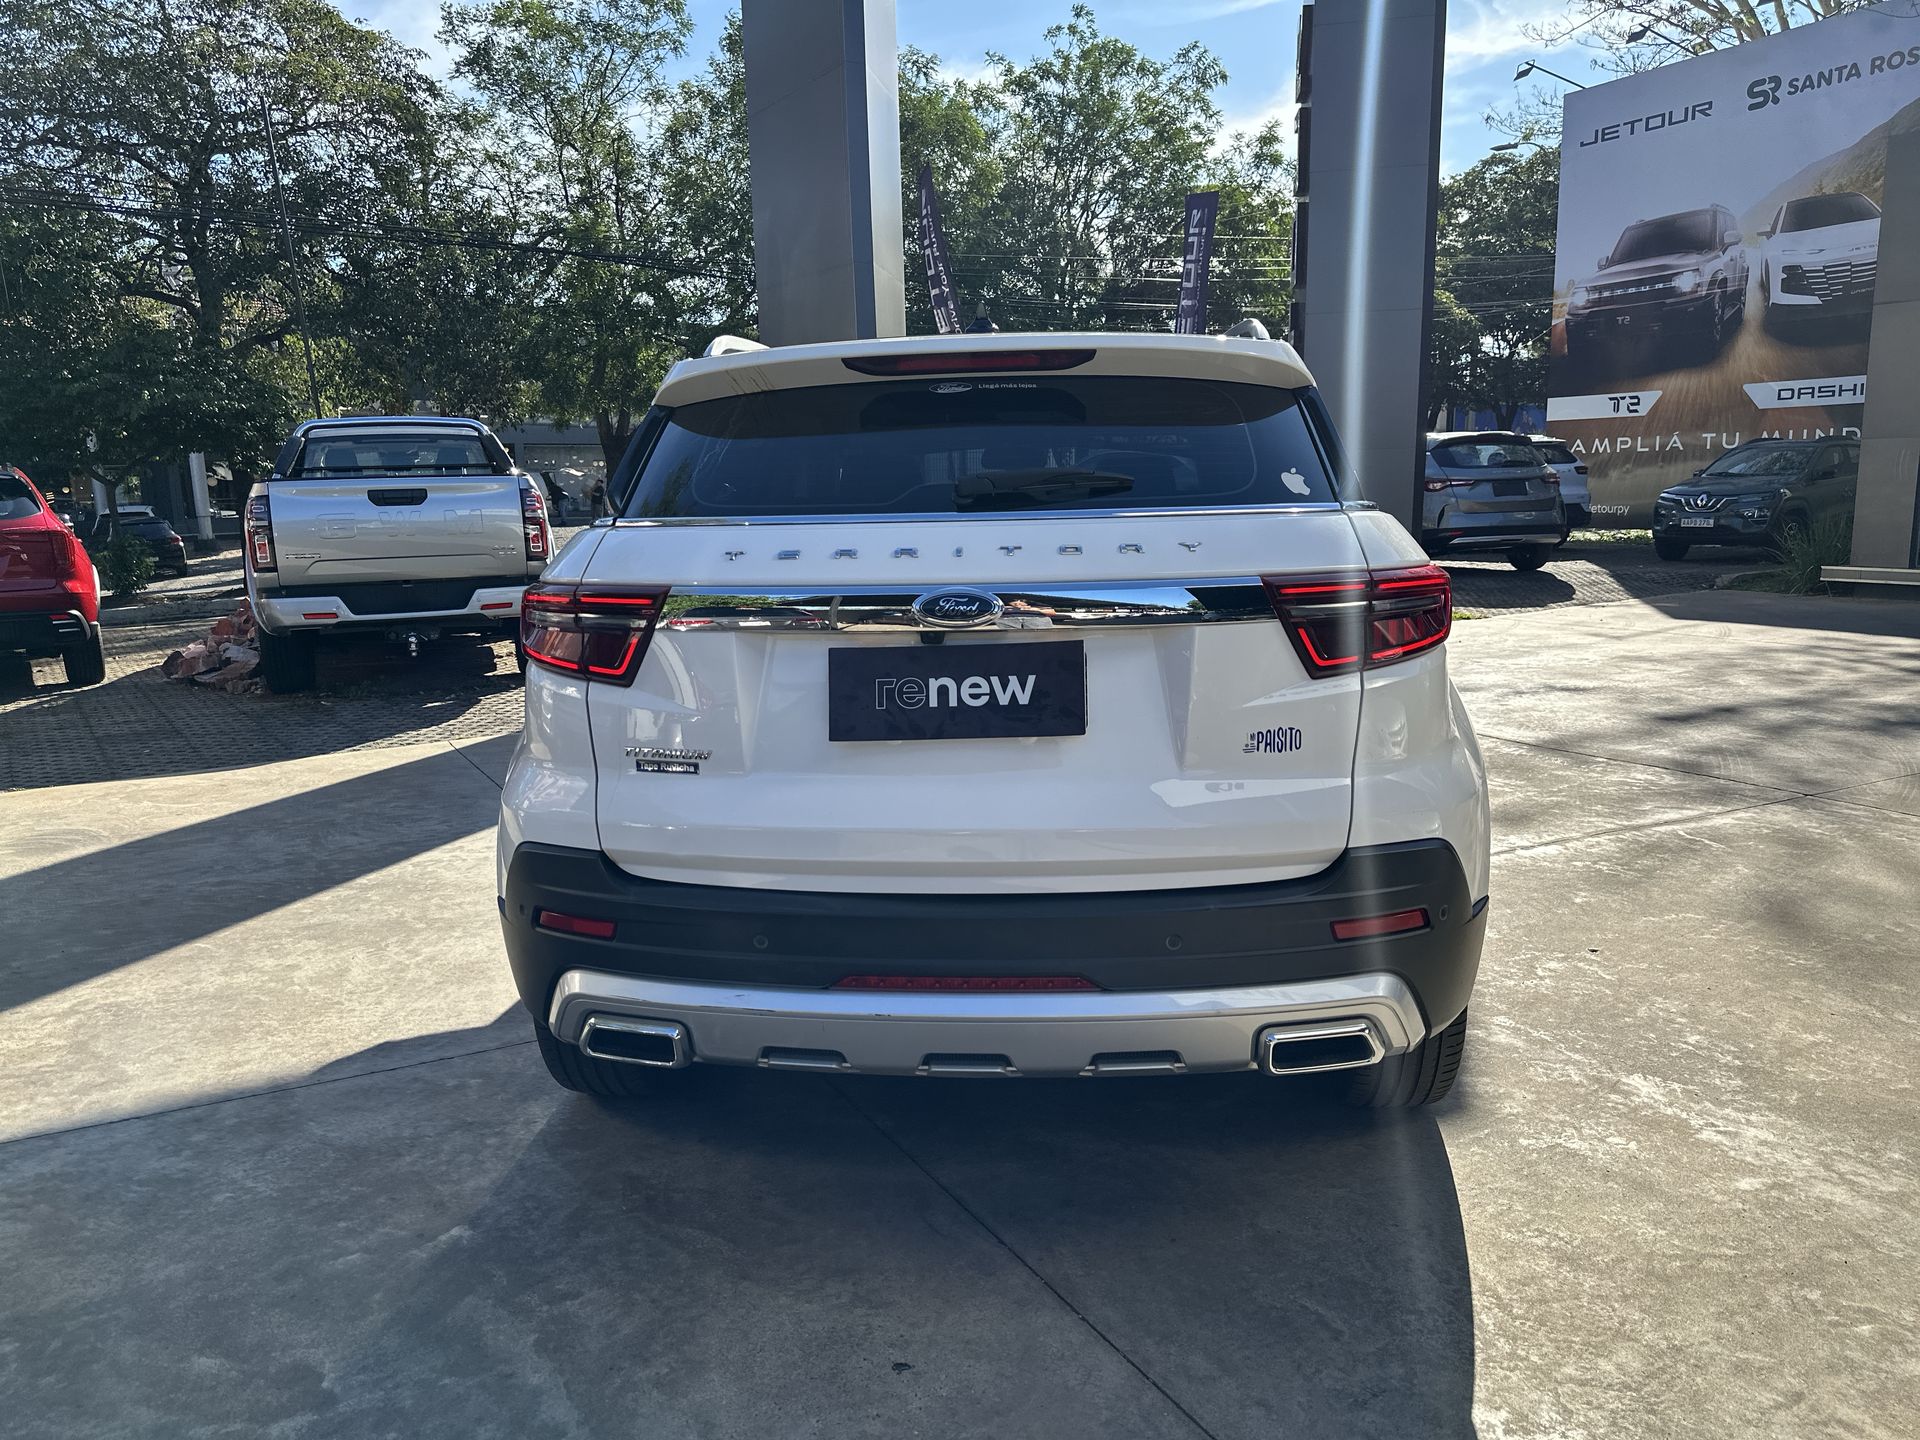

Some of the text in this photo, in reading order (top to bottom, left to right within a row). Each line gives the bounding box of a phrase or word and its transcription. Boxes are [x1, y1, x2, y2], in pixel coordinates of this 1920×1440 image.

[1787, 62, 1862, 96] SANTA
[1579, 100, 1713, 148] JETOUR
[937, 261, 950, 297] Your
[1616, 315, 1631, 325] T2
[1608, 395, 1641, 413] T2
[1570, 431, 1684, 454] AMPLIÁ
[1702, 432, 1740, 450] TU
[316, 508, 484, 540] GWM
[724, 541, 1202, 562] TERRITORY
[934, 597, 980, 616] Ford
[875, 674, 1037, 710] renew
[1256, 726, 1302, 753] PAISITO
[623, 746, 713, 760] TITANIUM
[640, 761, 659, 771] Tape
